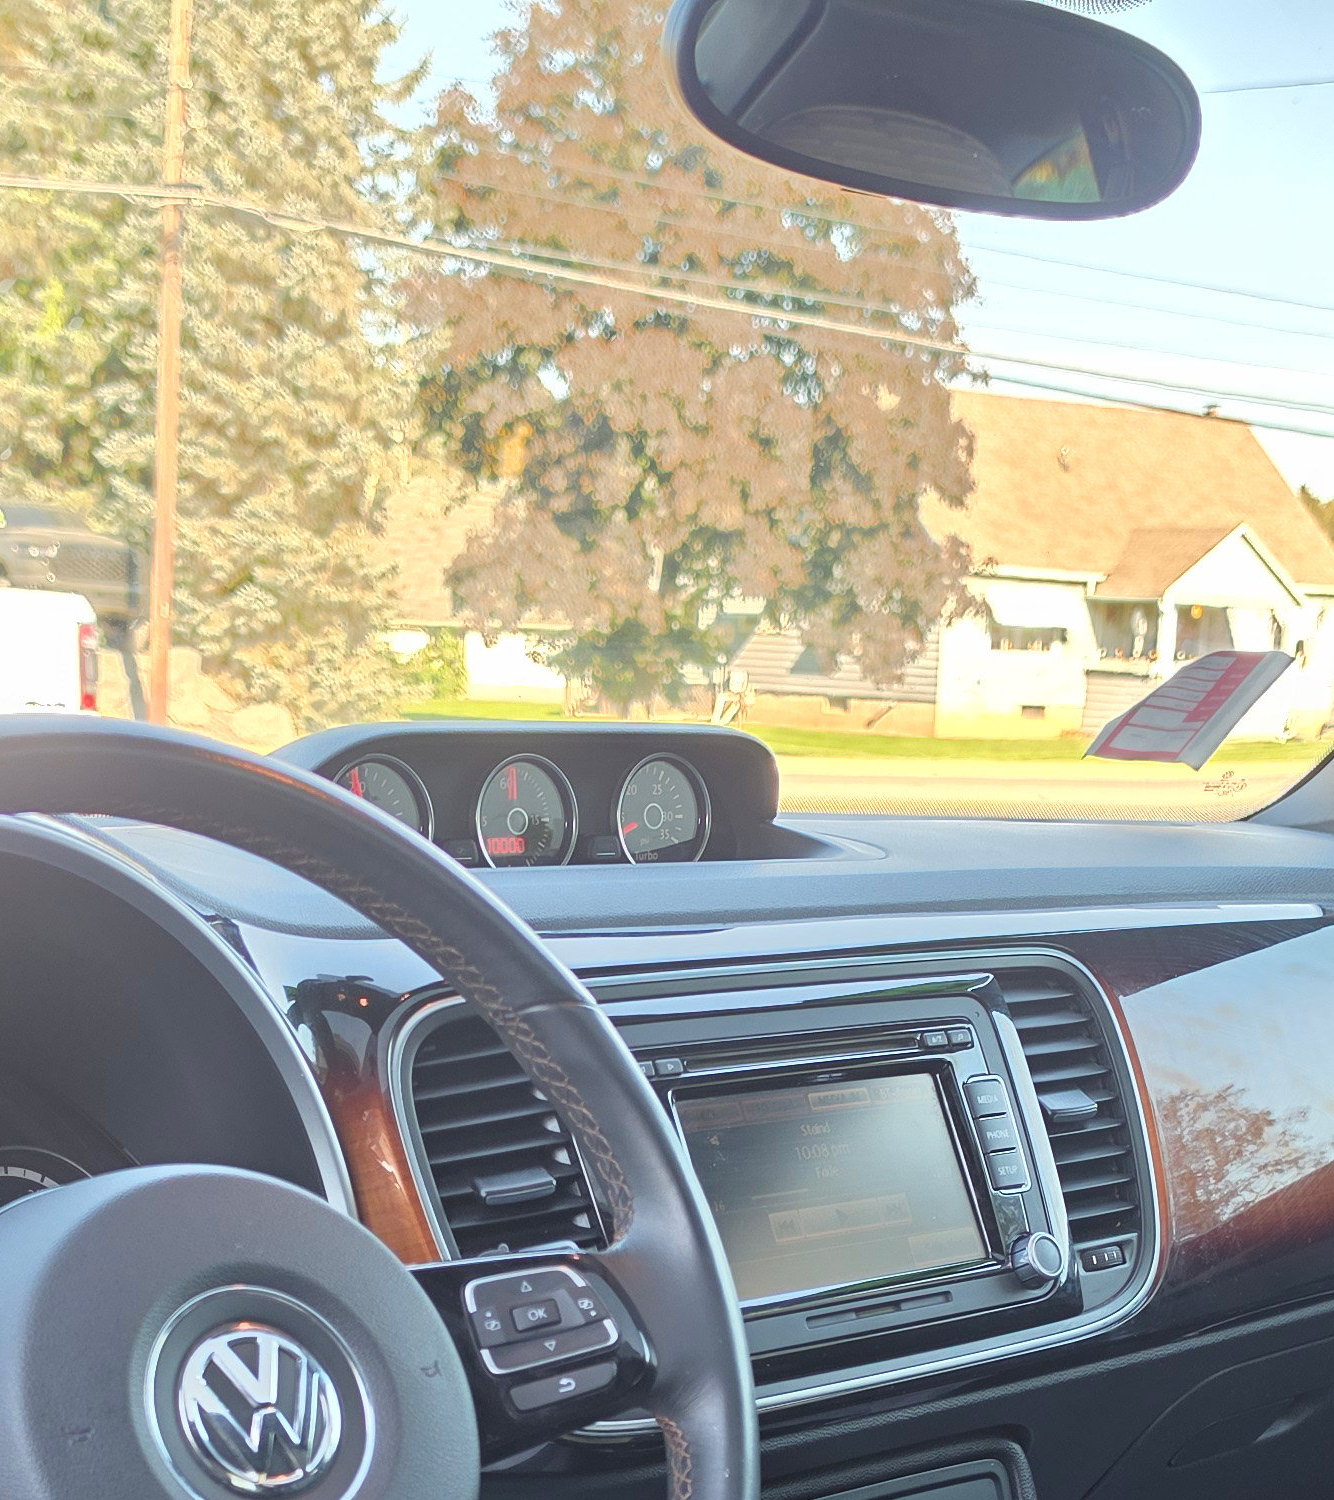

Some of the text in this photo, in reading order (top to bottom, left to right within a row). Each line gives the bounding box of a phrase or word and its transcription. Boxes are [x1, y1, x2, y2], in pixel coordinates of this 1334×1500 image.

[652, 784, 663, 795] 25
[660, 829, 670, 840] 35
[635, 851, 658, 860] Turbo
[977, 1095, 999, 1104] MEDIA
[986, 1129, 1010, 1139] PHONE
[998, 1166, 1018, 1176] SETUP
[527, 1307, 548, 1321] OK
